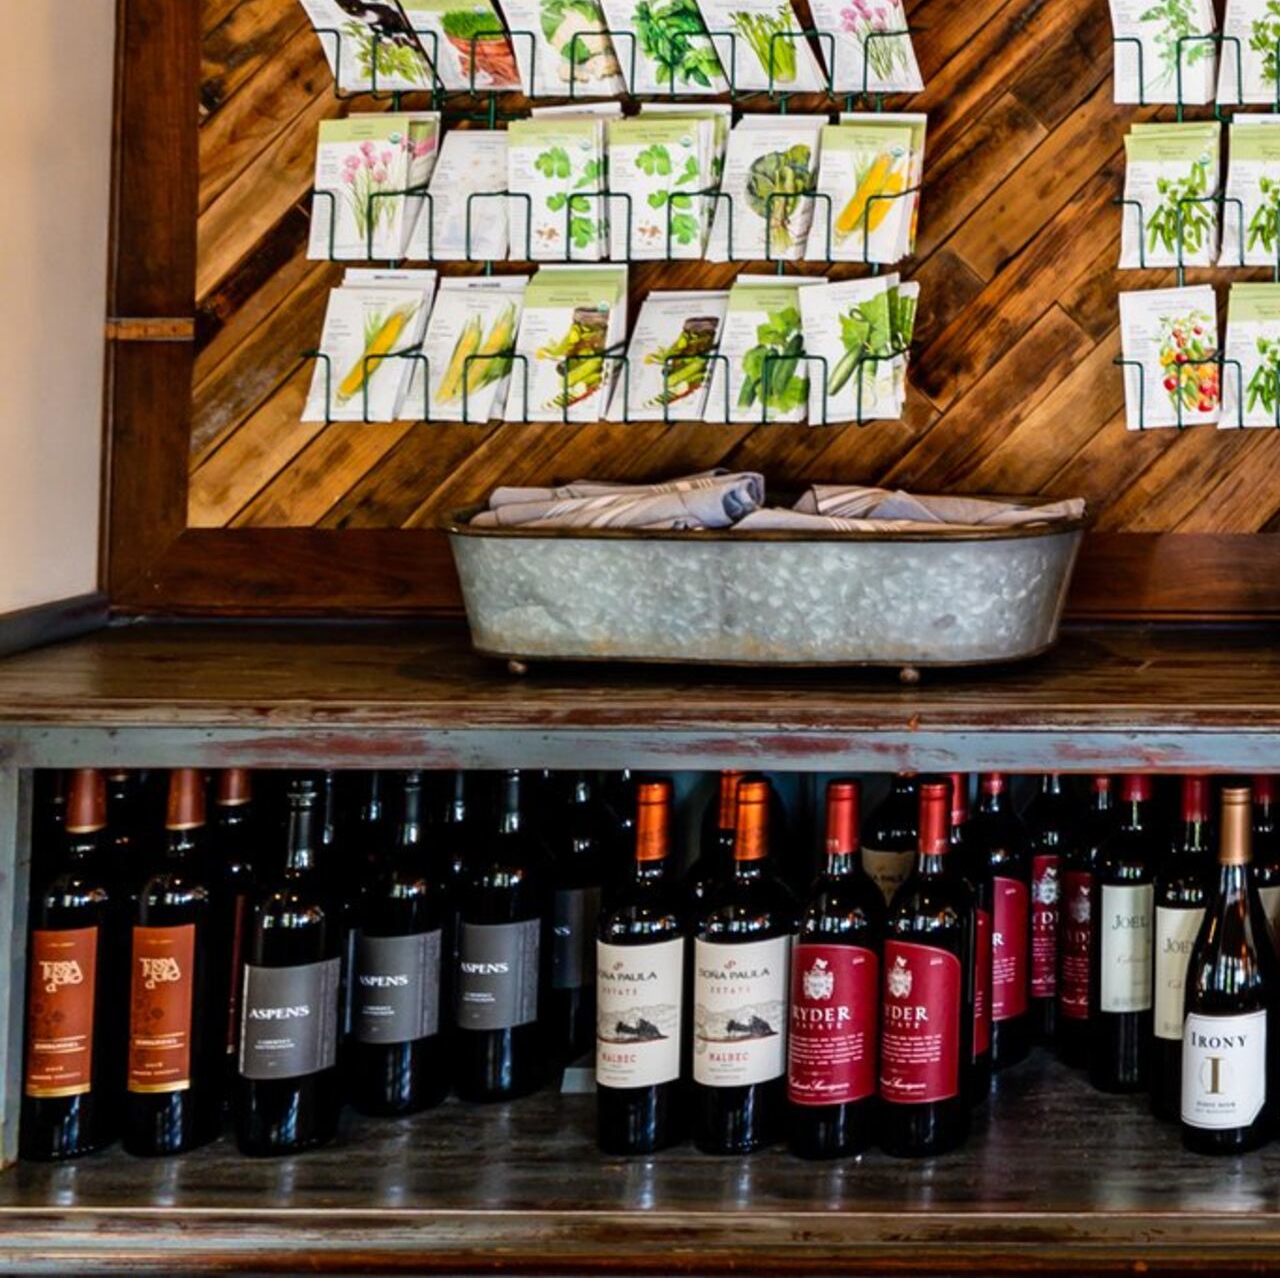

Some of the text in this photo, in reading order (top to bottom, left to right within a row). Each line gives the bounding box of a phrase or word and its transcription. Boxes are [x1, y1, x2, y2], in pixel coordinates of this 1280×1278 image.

[249, 1005, 311, 1020] ASPENS
[792, 1005, 852, 1022] RYDER
[885, 1006, 928, 1022] YDER
[1191, 1031, 1248, 1050] IRONY
[602, 1053, 637, 1064] MALBEC
[708, 1052, 749, 1063] MALBEC
